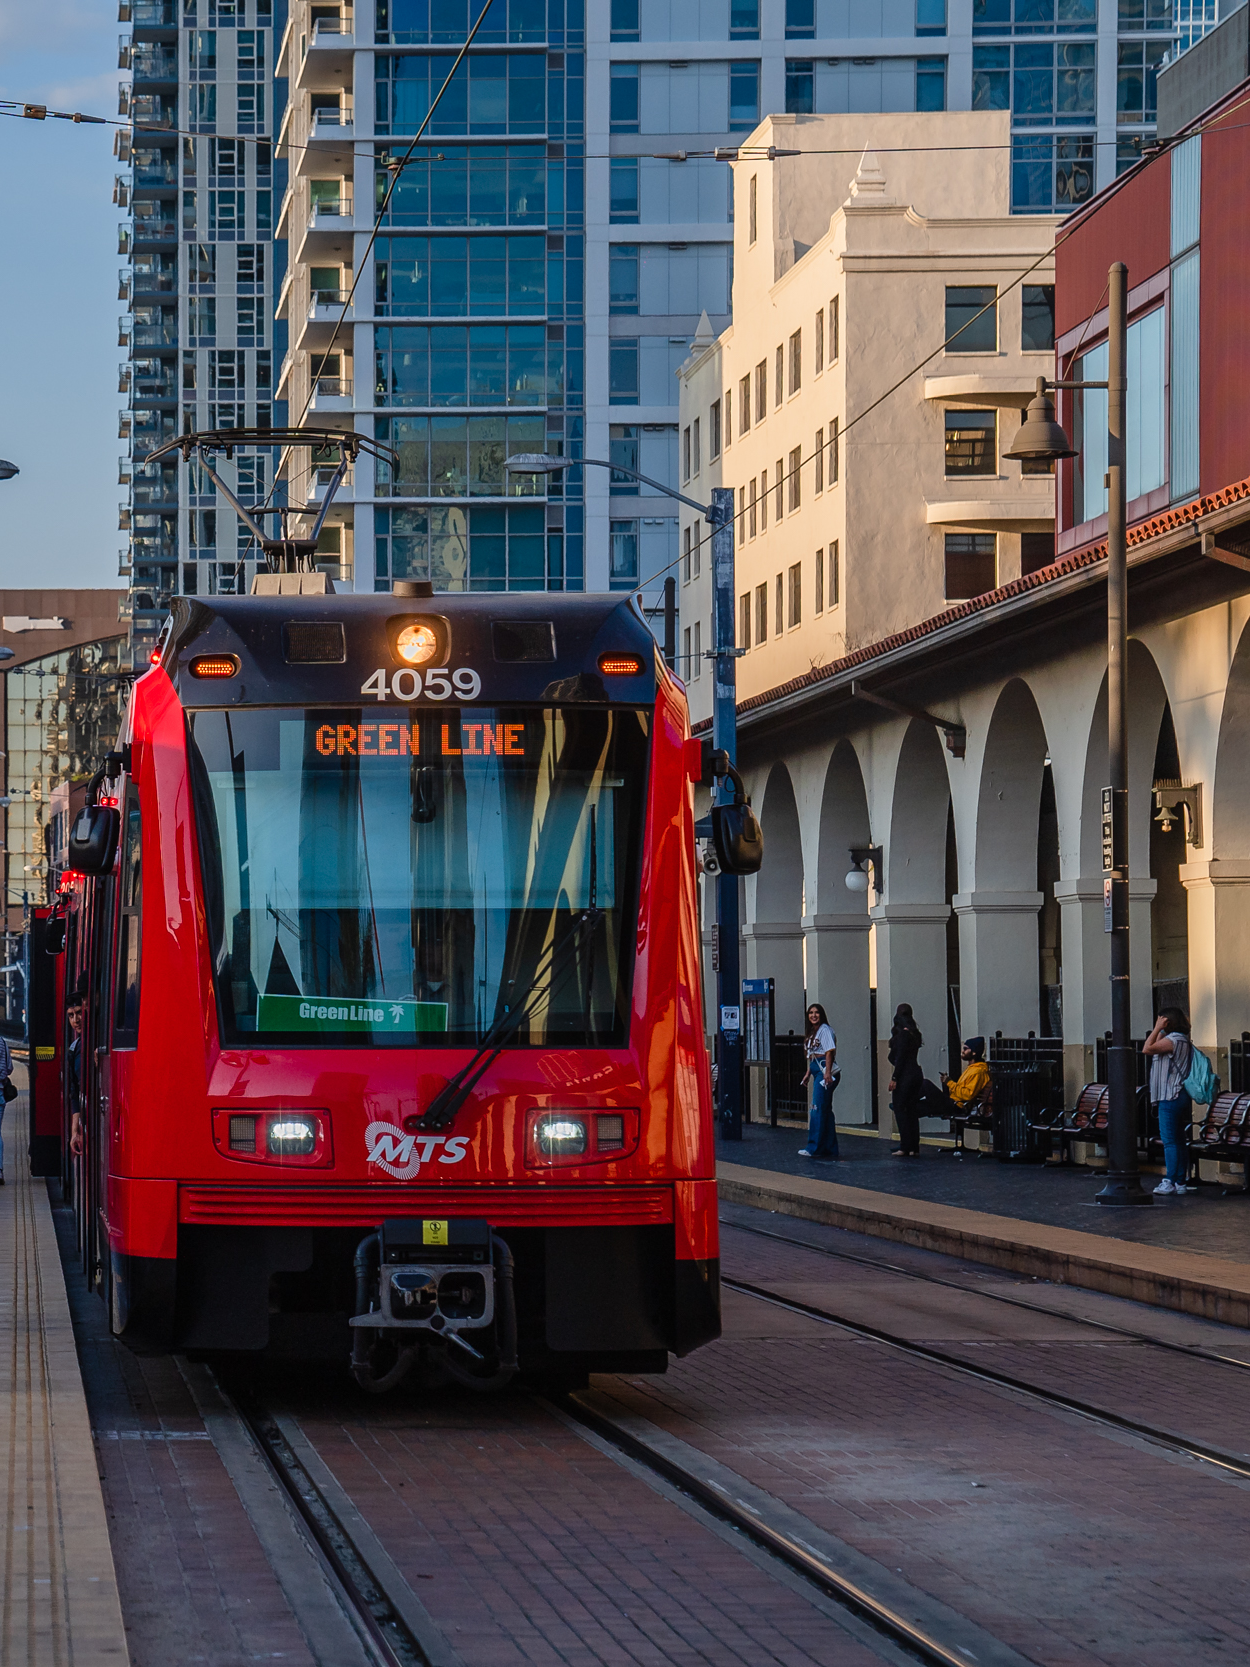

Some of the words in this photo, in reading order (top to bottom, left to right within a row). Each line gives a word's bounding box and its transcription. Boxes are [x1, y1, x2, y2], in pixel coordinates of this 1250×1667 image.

[360, 667, 482, 701] 4059
[316, 724, 420, 756] GREEN
[441, 724, 525, 756] LINE
[300, 1002, 348, 1020] Green
[350, 1005, 384, 1022] Line
[366, 1135, 470, 1164] MTS
